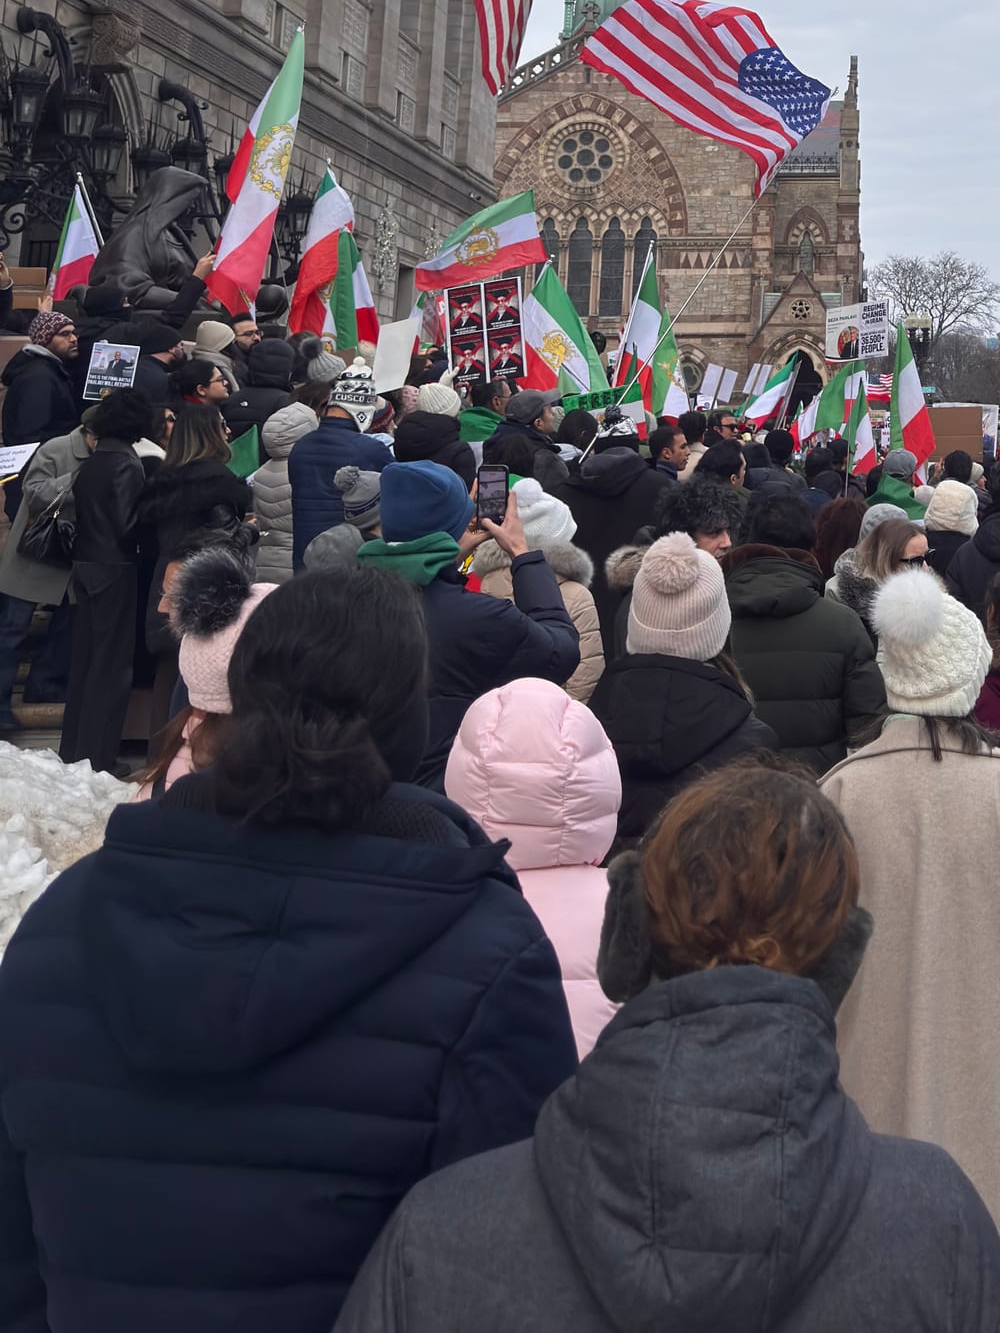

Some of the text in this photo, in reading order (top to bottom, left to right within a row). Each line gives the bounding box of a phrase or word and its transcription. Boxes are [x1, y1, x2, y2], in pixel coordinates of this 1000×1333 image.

[863, 303, 886, 312] REGIME
[861, 309, 887, 320] CHANGE
[335, 393, 365, 403] CUSCO
